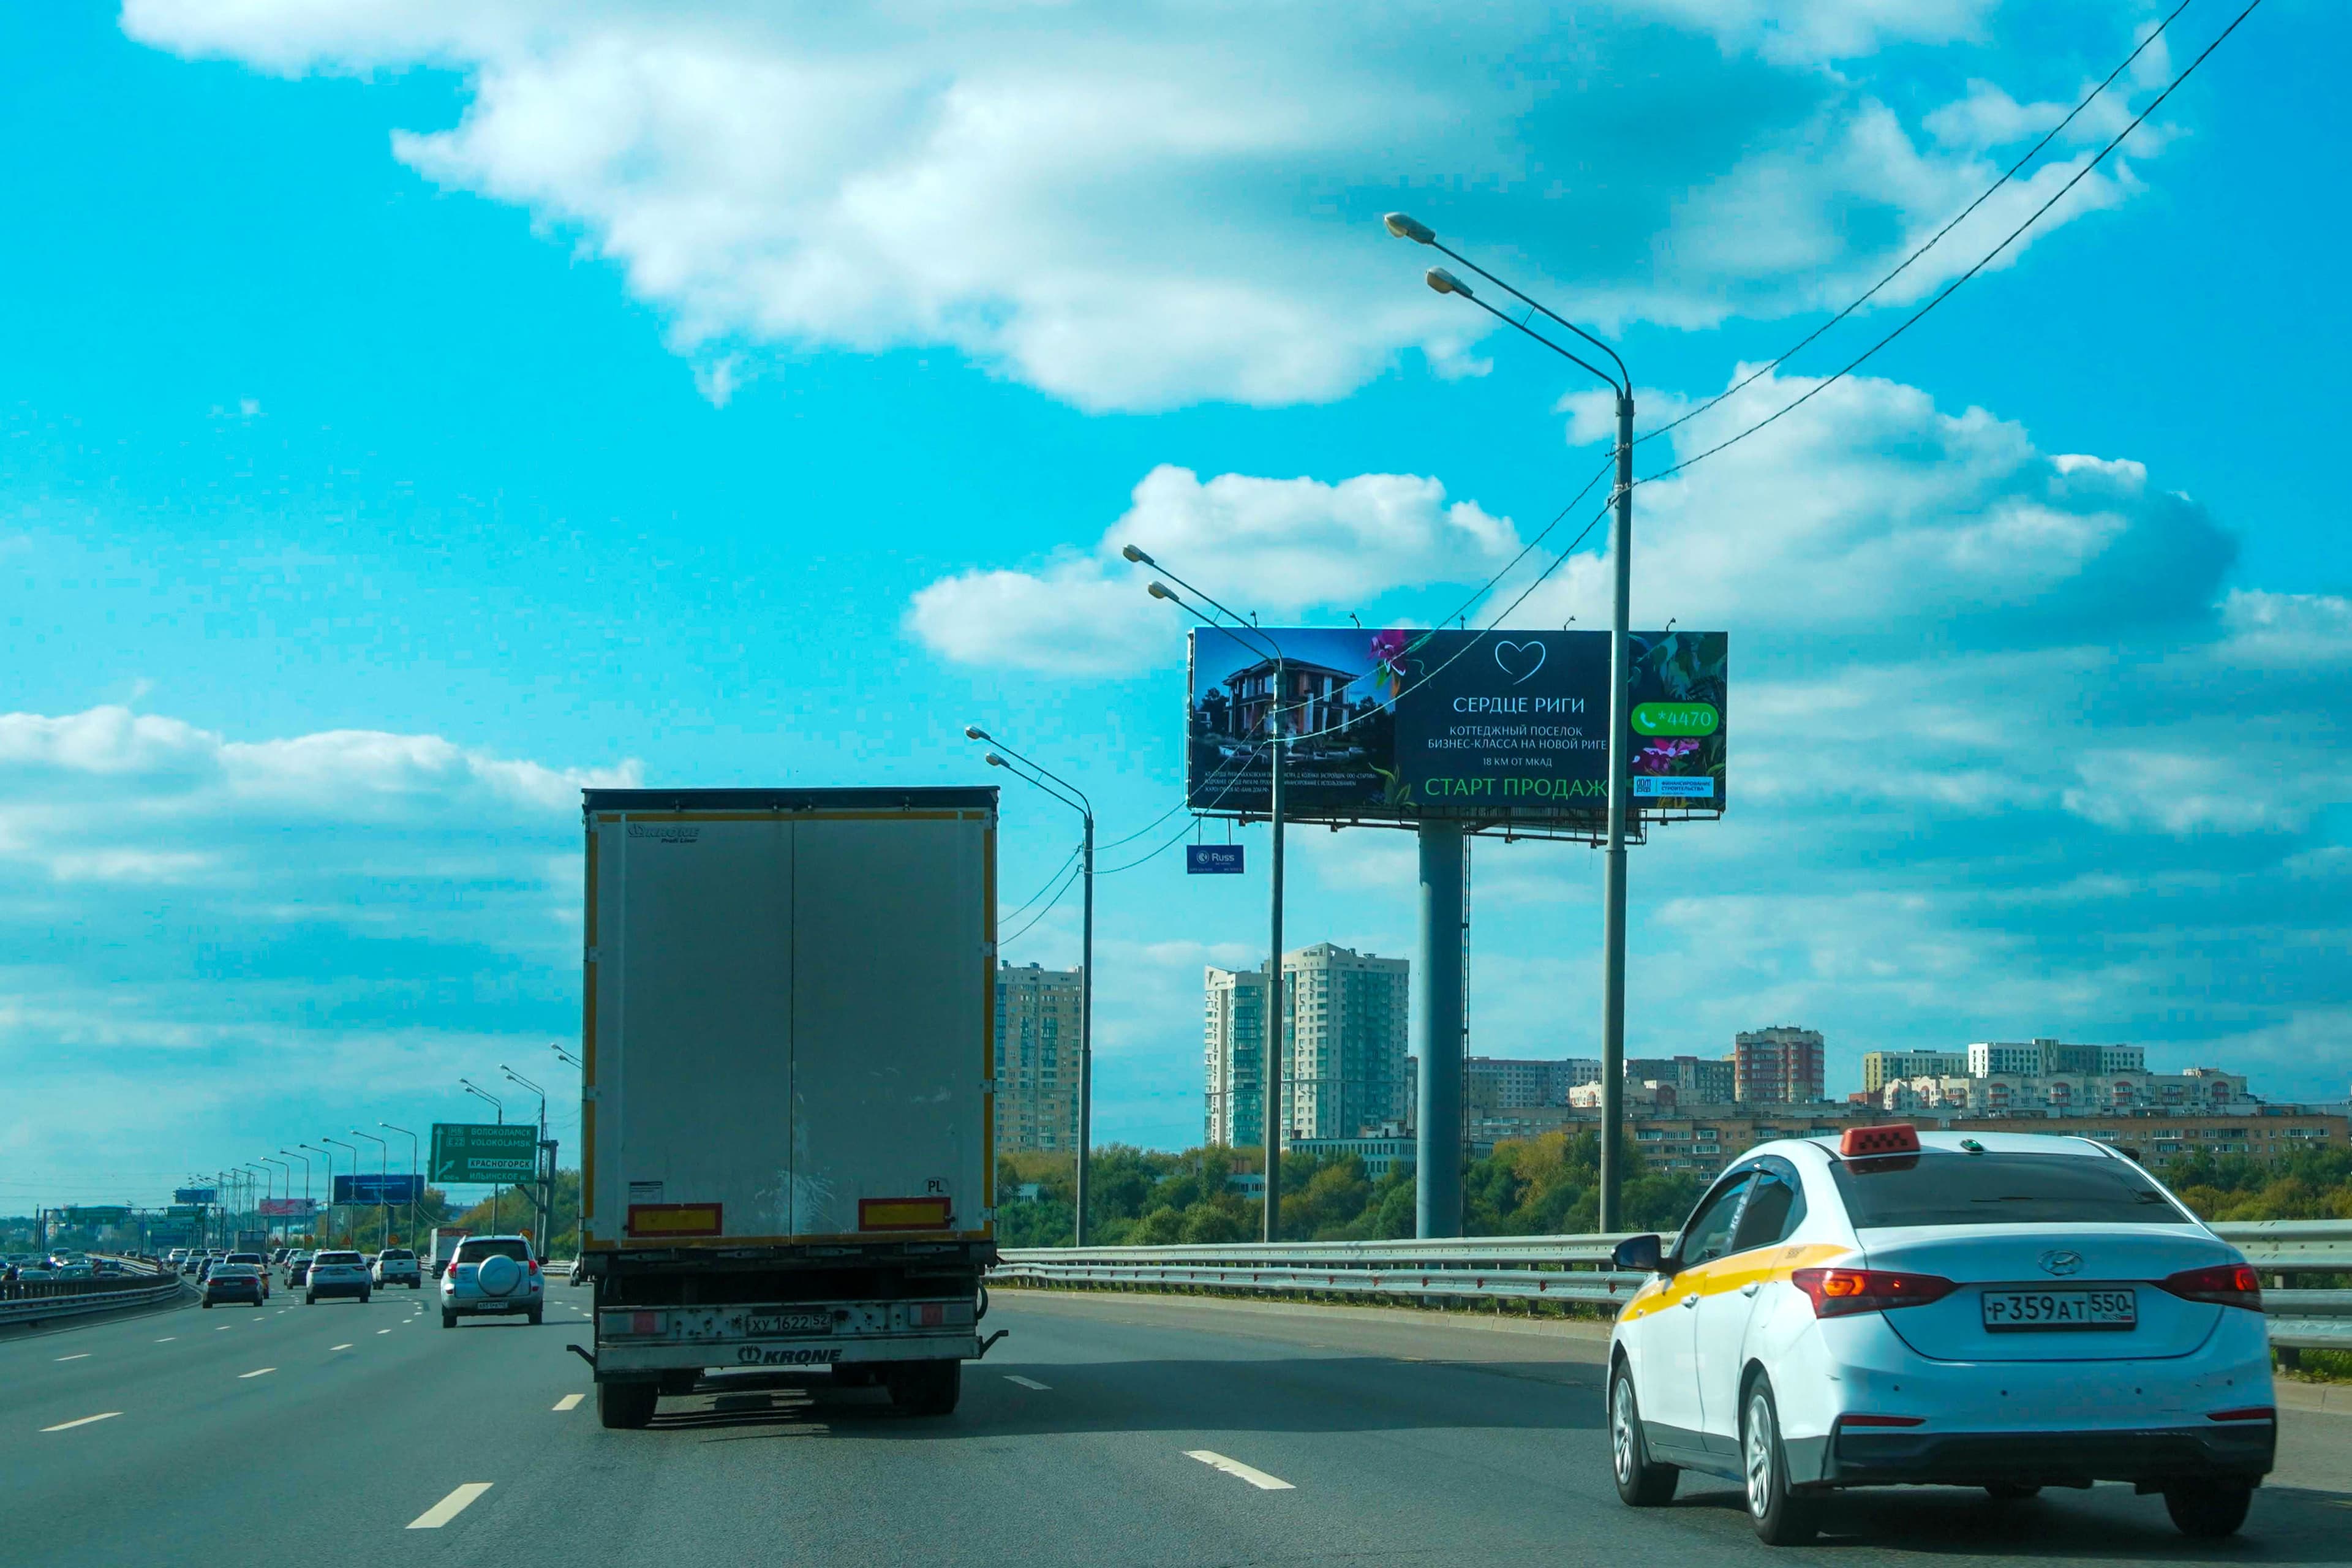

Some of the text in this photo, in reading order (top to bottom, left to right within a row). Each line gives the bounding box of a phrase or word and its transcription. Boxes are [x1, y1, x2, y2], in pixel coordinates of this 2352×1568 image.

[1453, 697, 1584, 714] СЕРДЦЕ РИГИ
[1450, 724, 1583, 737] КОТТЕДЖНЫЙ ПОСЕЛОК
[1428, 737, 1607, 750] БИЗНЕС-КЛАССА НА НОВОЙ РИГЕ
[1525, 758, 1552, 767] МКАД
[1425, 778, 1608, 800] СТАРТ ПРОДАЖ
[1212, 853, 1235, 862] Russ
[471, 1128, 531, 1136] ВОЛОКОЛАМСК
[471, 1139, 531, 1147] VOLOKOLAMSK
[470, 1172, 518, 1181] ИЛЬИНСКОЕ
[928, 1180, 943, 1192] PL
[2091, 1294, 2127, 1312] 550
[774, 1317, 809, 1330] 1622
[763, 1349, 842, 1363] KRONE
